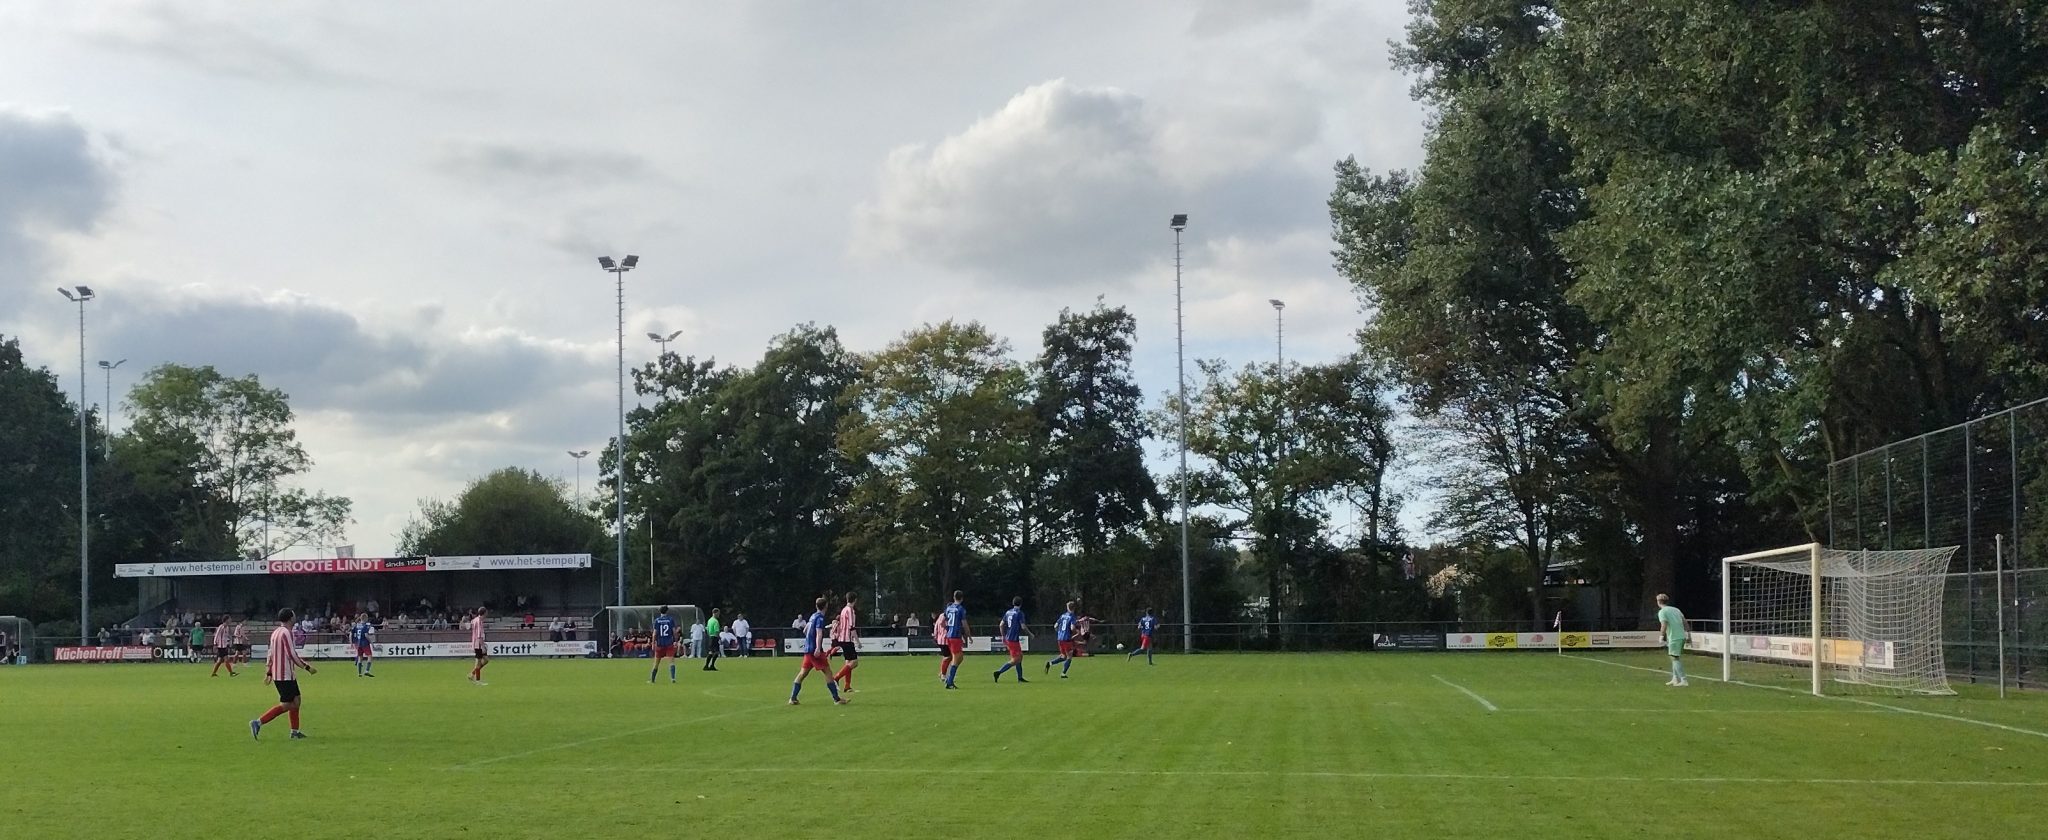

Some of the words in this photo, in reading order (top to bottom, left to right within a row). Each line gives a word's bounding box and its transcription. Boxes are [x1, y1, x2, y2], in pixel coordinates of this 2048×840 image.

[164, 562, 255, 573] www.het-stempel.nl
[271, 560, 333, 572] GROOTE
[336, 559, 381, 571] LINDT
[490, 555, 589, 568] www.het-stempel.nl
[947, 612, 956, 627] 21
[660, 624, 669, 637] 12
[55, 646, 122, 661] KüchenTreff
